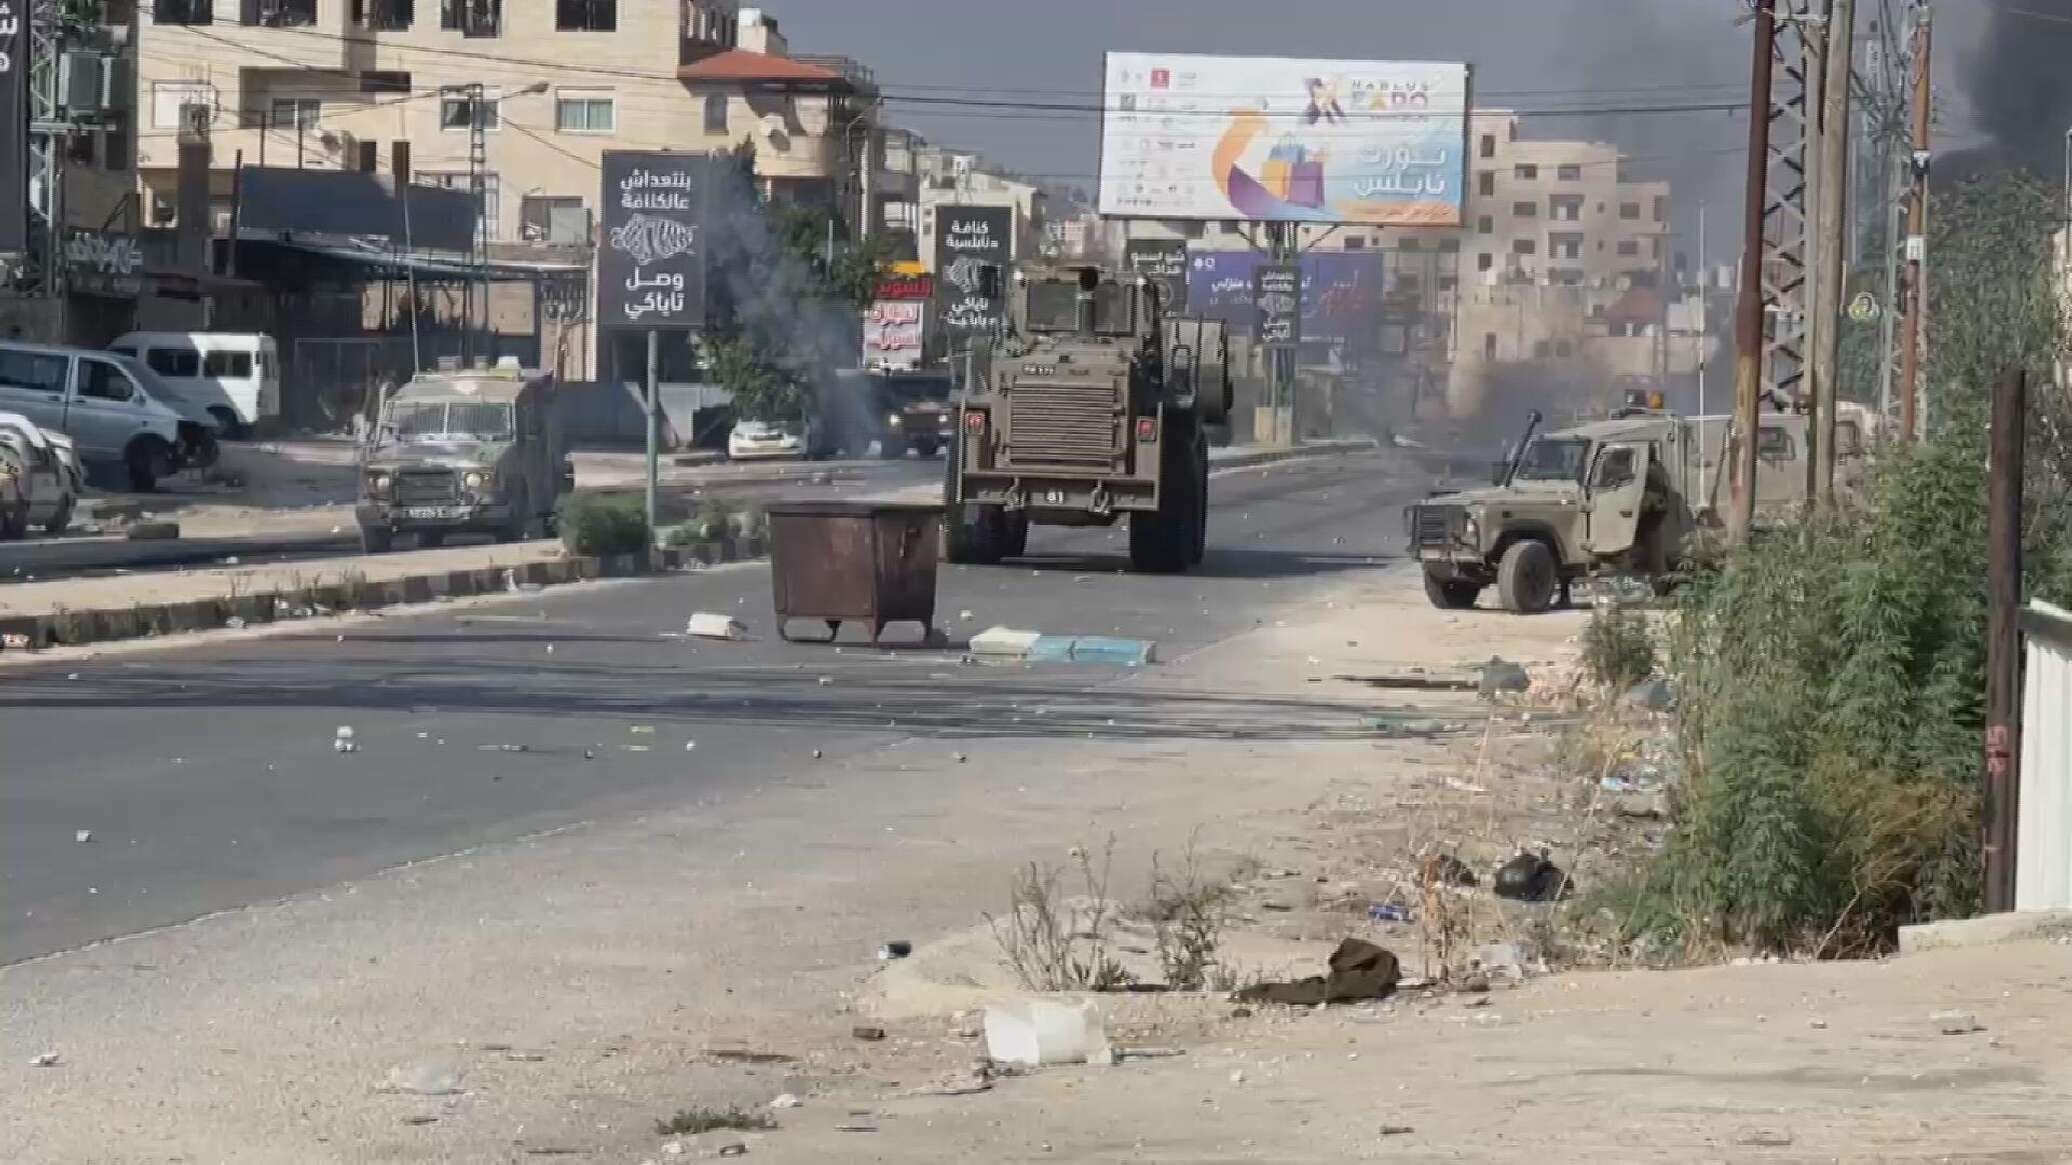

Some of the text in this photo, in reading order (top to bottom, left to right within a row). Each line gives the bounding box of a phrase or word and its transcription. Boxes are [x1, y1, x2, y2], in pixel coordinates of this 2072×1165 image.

[1360, 142, 1446, 171] نورت
[1352, 171, 1446, 199] نابلس
[625, 266, 685, 291] وصل
[624, 291, 685, 320] تاياكي
